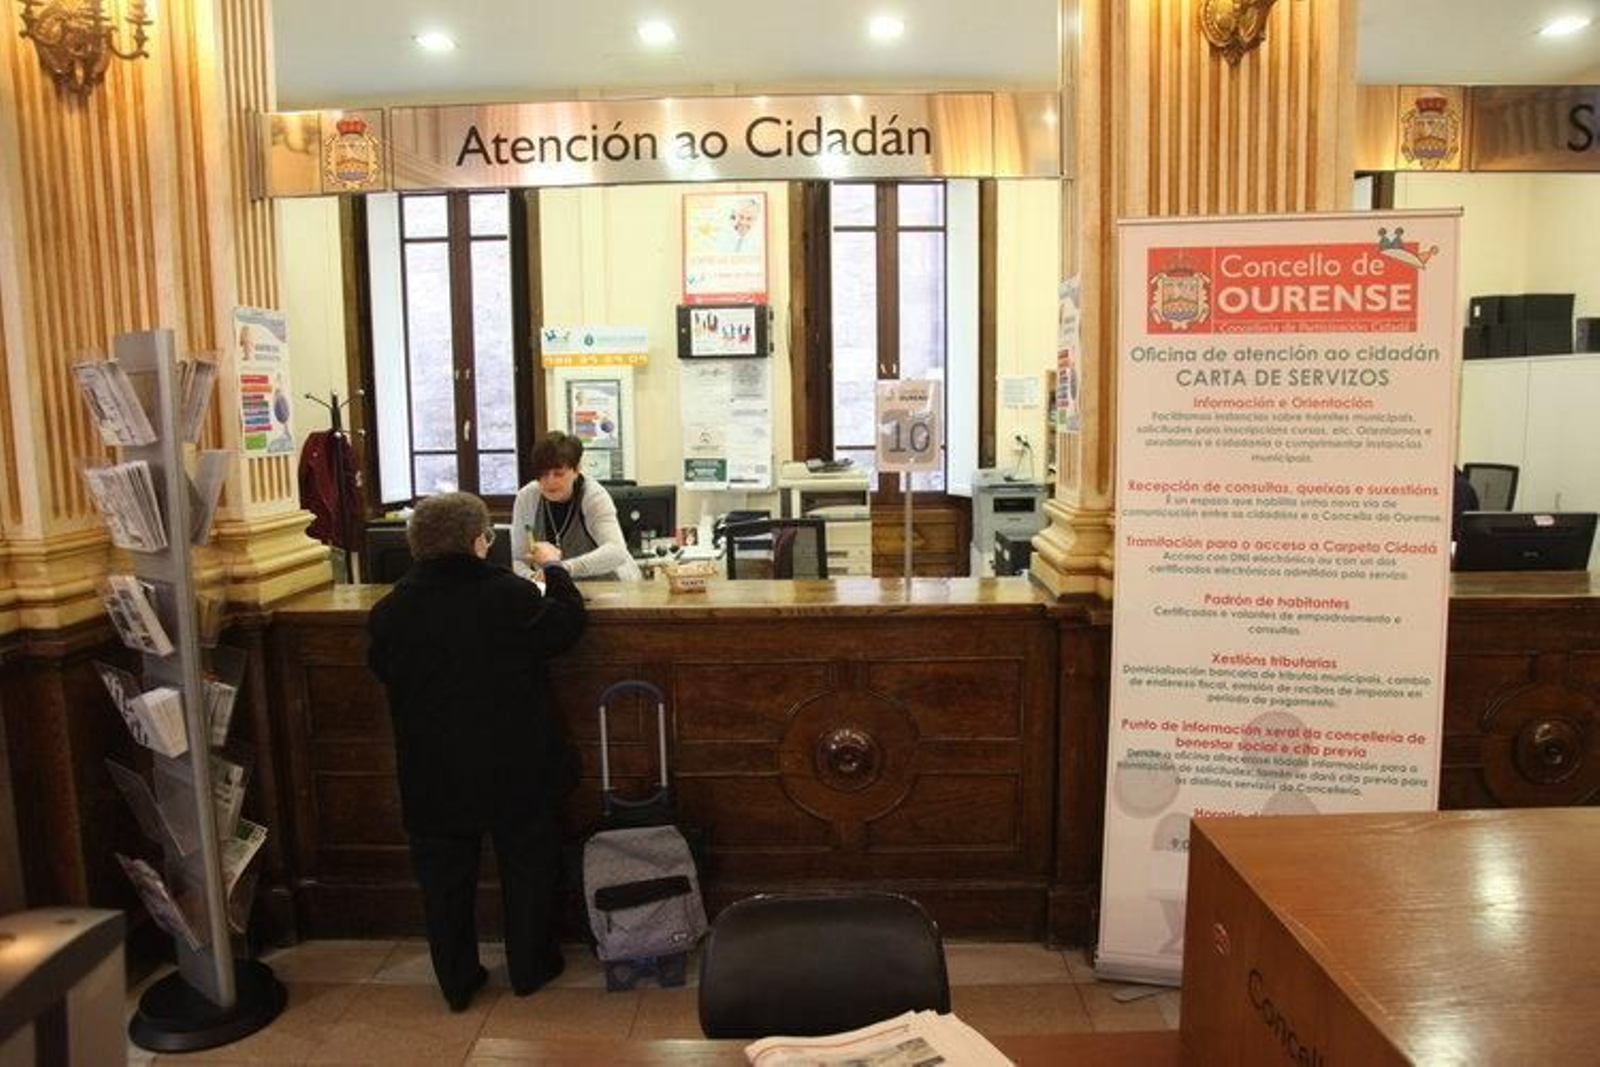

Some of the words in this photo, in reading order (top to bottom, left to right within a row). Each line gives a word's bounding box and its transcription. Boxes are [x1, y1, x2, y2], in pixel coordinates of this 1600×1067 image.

[456, 121, 658, 167] Atención
[675, 131, 728, 159] ao
[745, 114, 931, 158] Cidadán
[1221, 253, 1341, 279] Concello
[1352, 253, 1385, 276] de
[1218, 284, 1412, 314] OURENSE
[1131, 347, 1197, 362] Oficina
[1203, 347, 1227, 362] de
[1233, 344, 1318, 362] atención
[1324, 348, 1351, 361] ao
[1356, 343, 1440, 361] cidadán
[1177, 369, 1246, 386] CARTA
[1255, 369, 1281, 386] DE
[1288, 368, 1389, 386] SERVIZOS
[1194, 396, 1277, 408] Información
[1278, 400, 1286, 408] e
[1292, 397, 1374, 408] Orientación
[887, 421, 931, 454] 10
[1128, 480, 1198, 493] Recepción
[1203, 482, 1220, 491] de
[1297, 484, 1350, 495] queixas
[1355, 485, 1363, 495] e
[1367, 485, 1437, 495] suxestións
[1127, 536, 1202, 548] Tramitación
[1206, 540, 1237, 550] para
[1242, 541, 1250, 549] o
[1324, 540, 1380, 554] Carpeta
[1205, 594, 1252, 605] Padrón
[1256, 597, 1273, 606] de
[1277, 597, 1349, 609] habitantes
[1212, 653, 1266, 666] Xestións
[1270, 655, 1337, 669] tributarias
[1122, 719, 1157, 730] Punto
[1161, 720, 1178, 731] de
[1182, 721, 1261, 736] información
[1264, 727, 1299, 738] xeral
[1407, 733, 1425, 744] de
[1175, 738, 1233, 749] benestar
[1238, 741, 1277, 751] social
[1281, 744, 1289, 753] e
[1294, 744, 1319, 755] cita
[1323, 747, 1366, 758] previa
